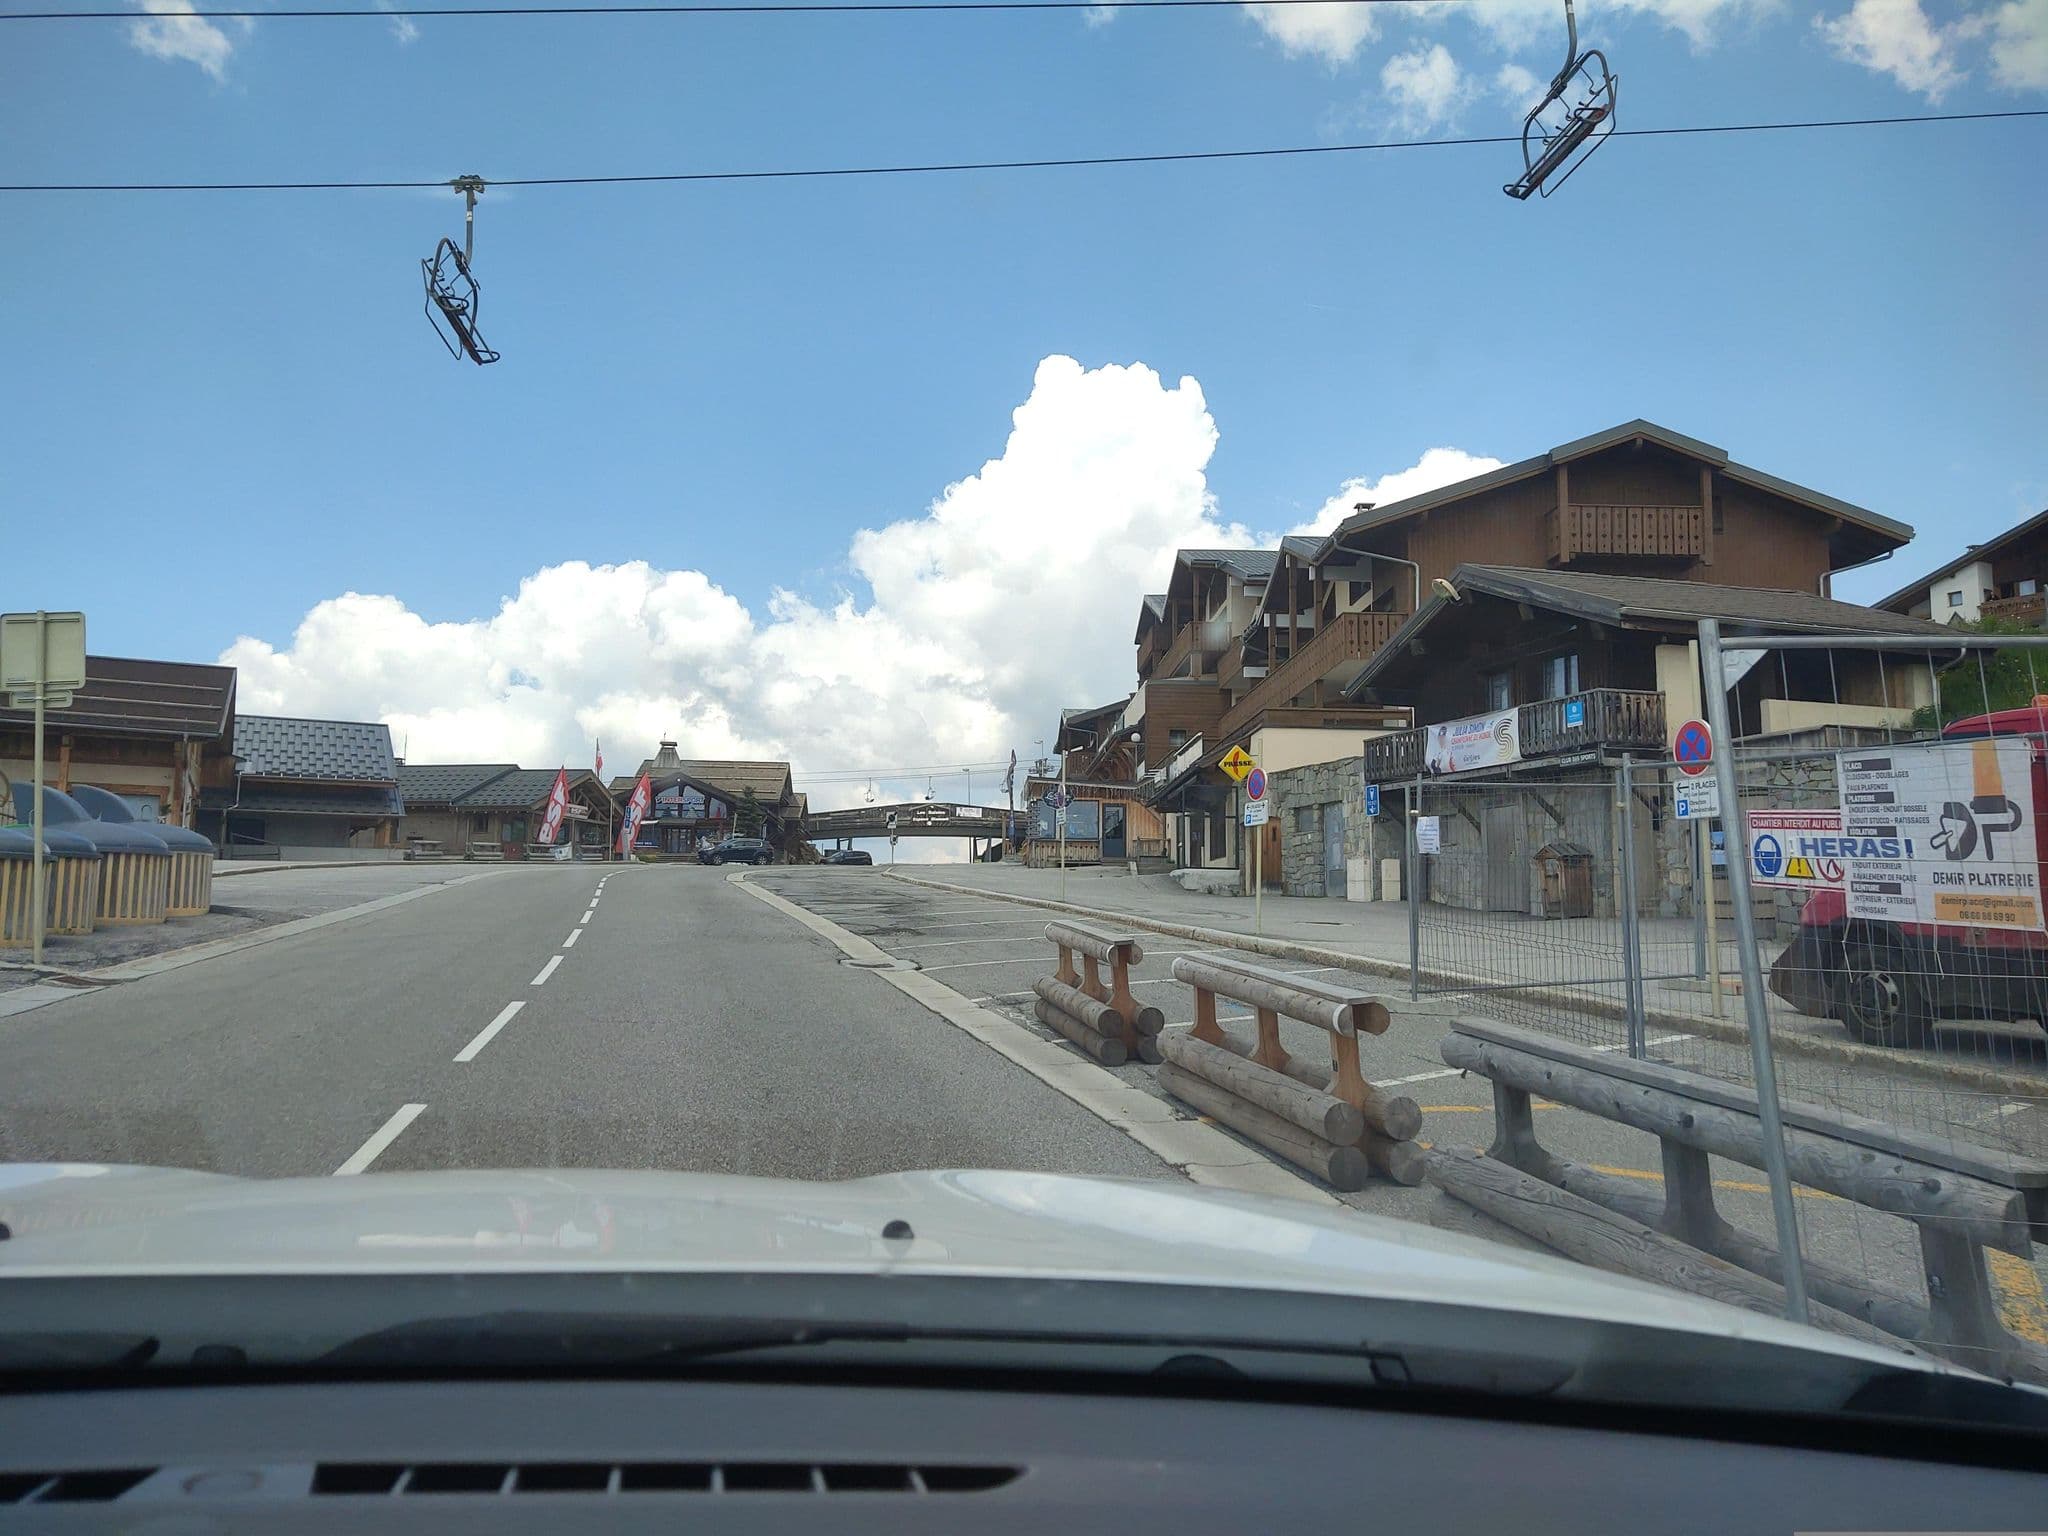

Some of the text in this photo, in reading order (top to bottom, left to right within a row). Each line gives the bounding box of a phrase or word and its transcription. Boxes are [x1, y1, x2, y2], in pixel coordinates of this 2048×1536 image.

[1844, 762, 1862, 770] PLACO
[1695, 780, 1716, 789] PLACES
[662, 796, 705, 804] INTERSPORT
[1752, 819, 1782, 827] CHANTIER
[1784, 819, 1810, 827] INTERDIT
[1822, 819, 1841, 828] PUBLI
[1968, 873, 2034, 887] PLATRERIE
